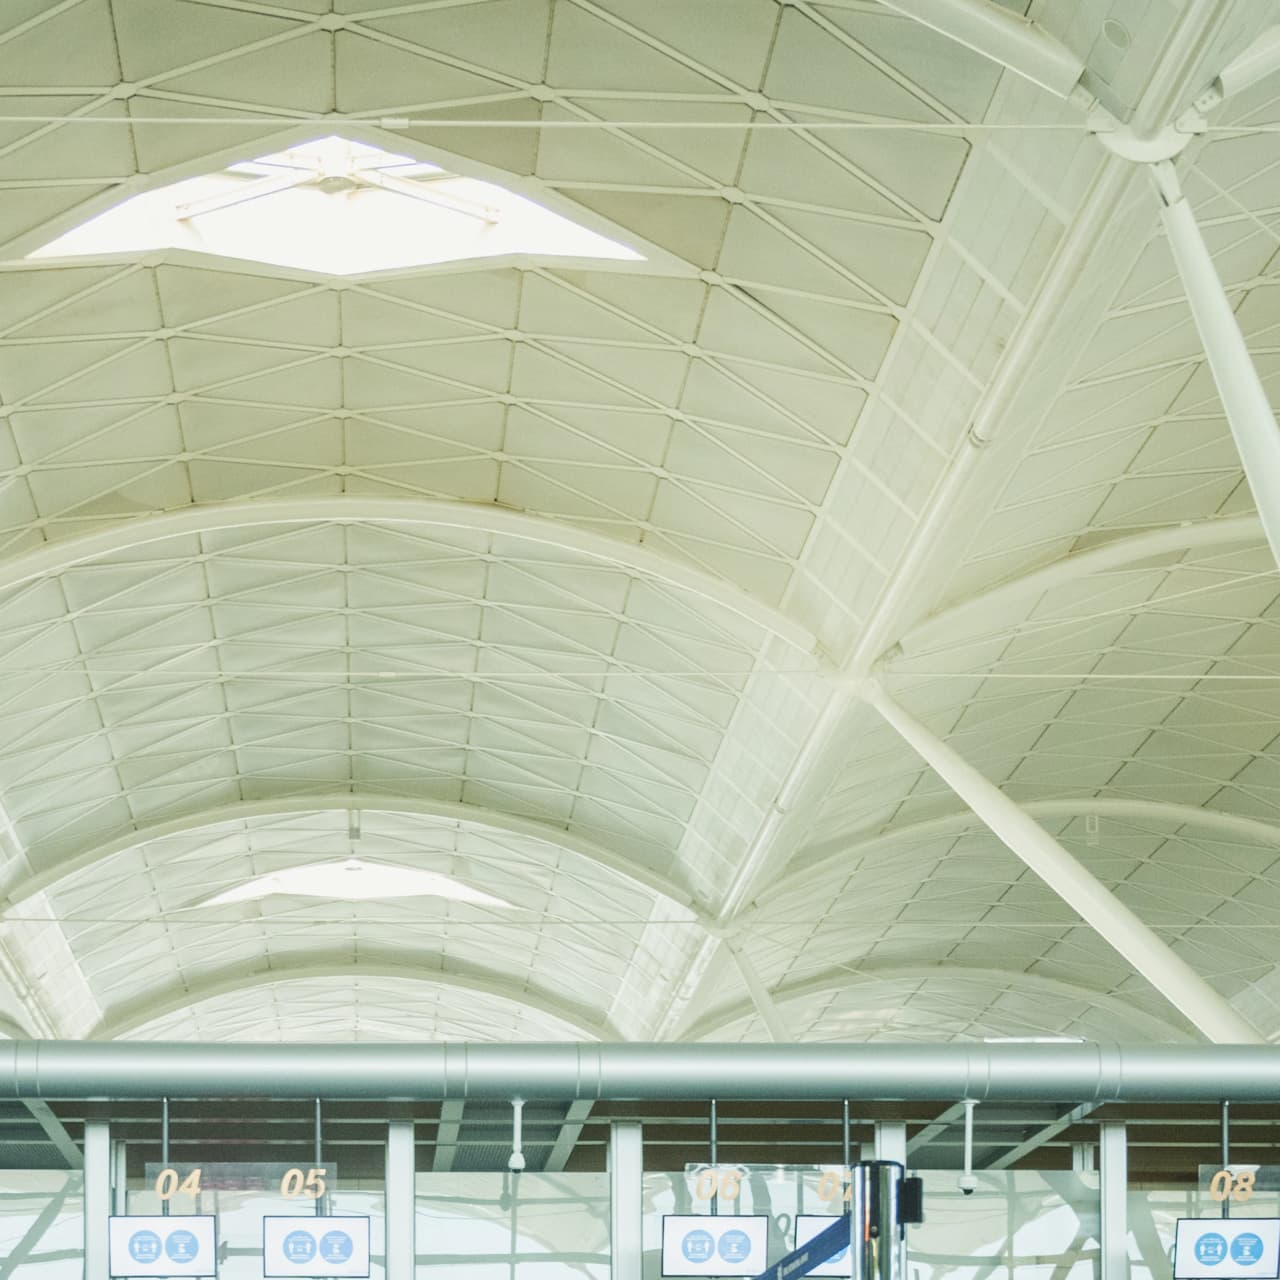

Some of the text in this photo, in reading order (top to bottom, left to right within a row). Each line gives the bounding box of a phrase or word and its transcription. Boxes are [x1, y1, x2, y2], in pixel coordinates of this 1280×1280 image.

[155, 1168, 202, 1200] 04
[280, 1168, 328, 1200] 05
[696, 1169, 741, 1201] 06
[1210, 1170, 1256, 1202] 08
